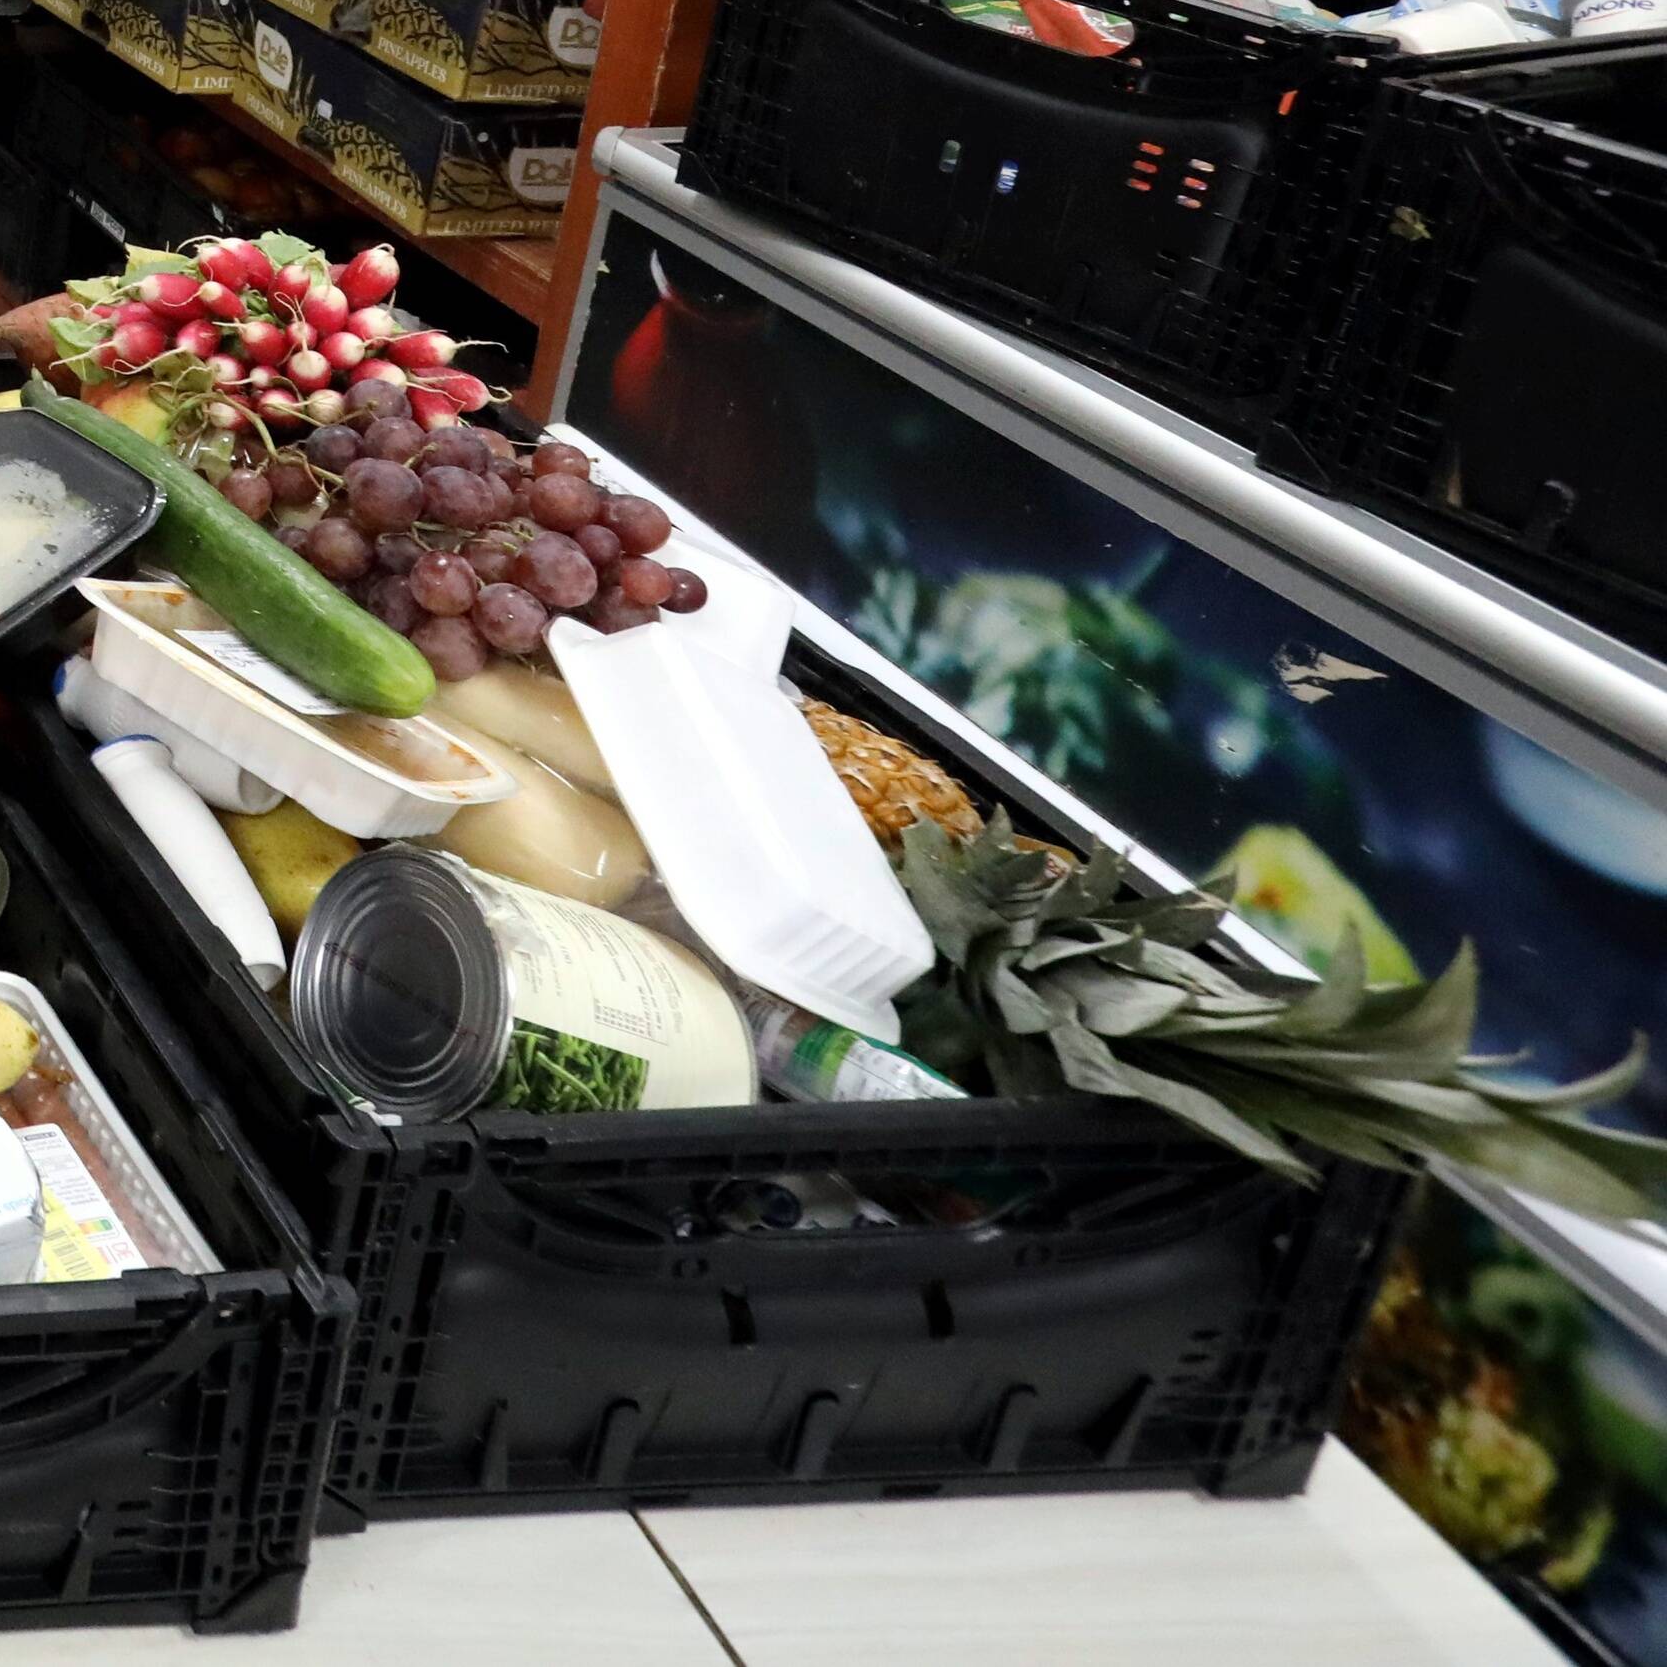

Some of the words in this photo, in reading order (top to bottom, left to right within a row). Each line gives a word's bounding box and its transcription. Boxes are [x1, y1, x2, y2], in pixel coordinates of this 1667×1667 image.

[559, 18, 601, 43] Do
[258, 38, 290, 72] Dole
[377, 36, 448, 84] PINEAPPLES
[193, 77, 233, 90] LIMI
